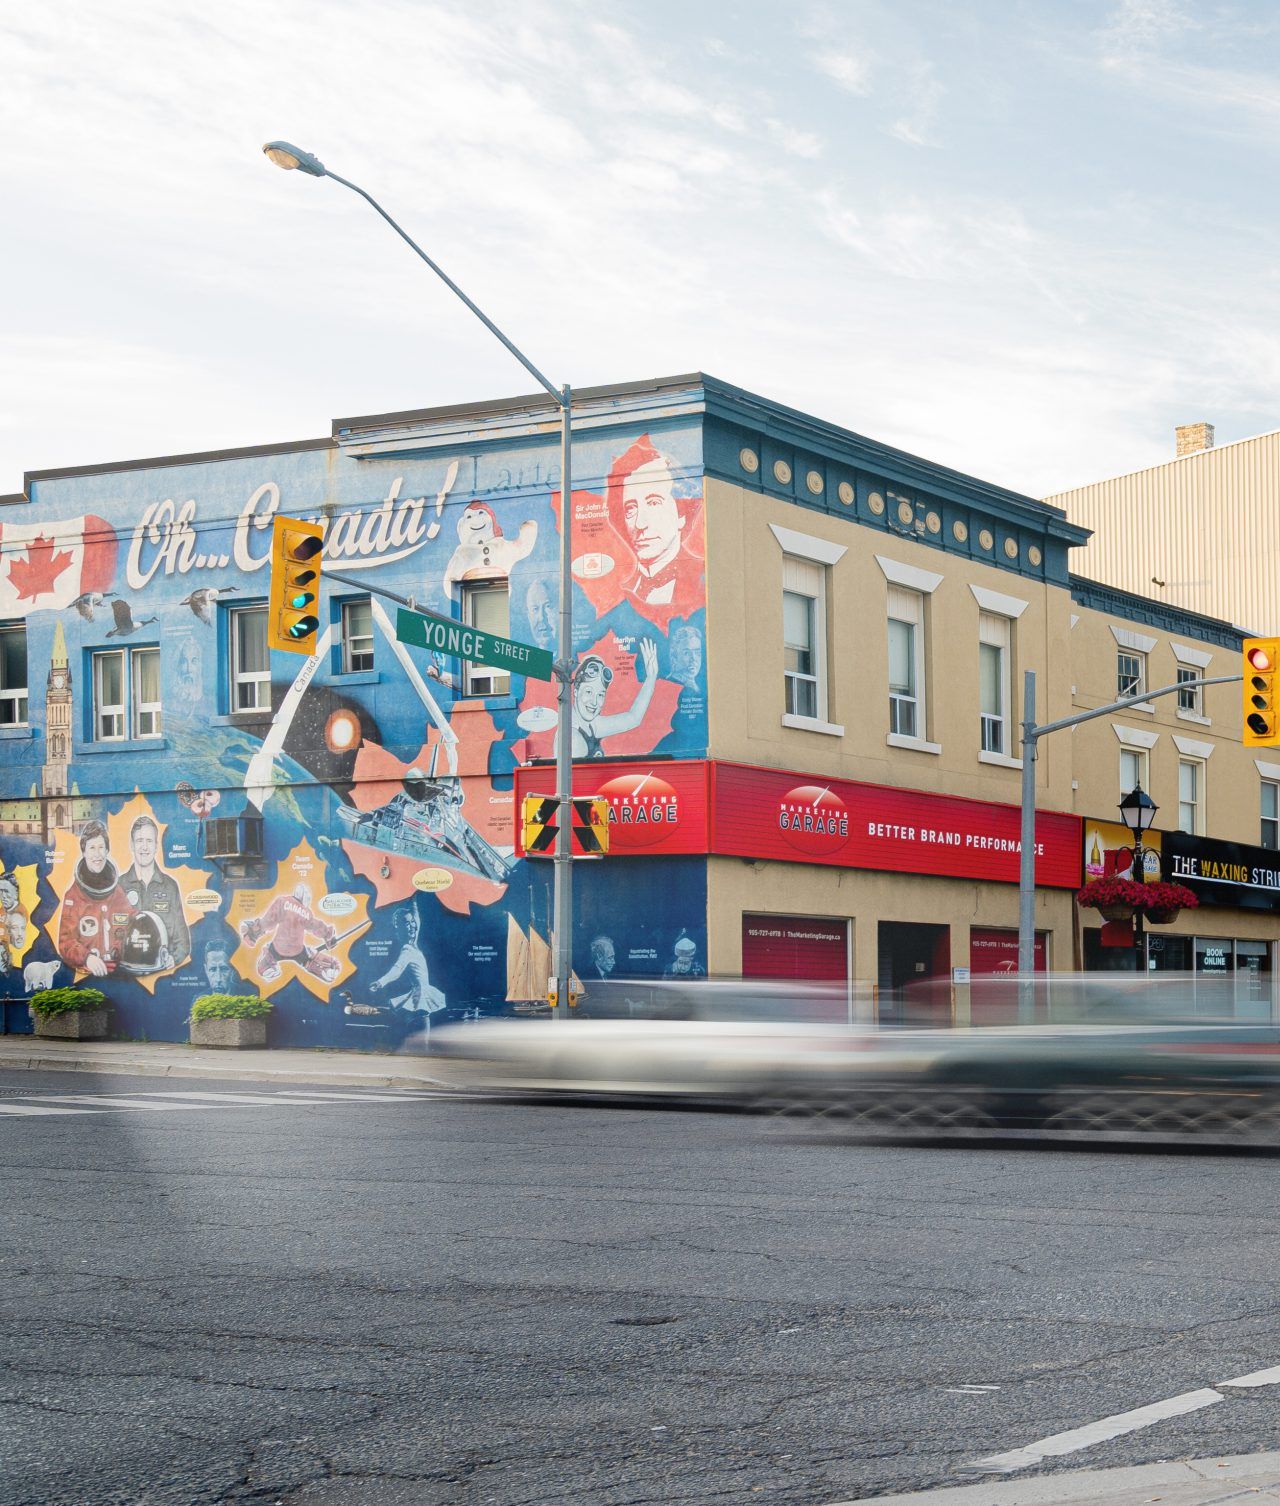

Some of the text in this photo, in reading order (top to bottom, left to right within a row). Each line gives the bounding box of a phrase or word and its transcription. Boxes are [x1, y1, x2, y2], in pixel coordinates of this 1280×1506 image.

[233, 460, 459, 572] Cada!
[423, 620, 531, 662] YONGE STREET
[294, 654, 320, 692] Canada
[603, 796, 677, 805] RKETING
[780, 803, 848, 819] MARKETING
[607, 804, 678, 824] ARAGE
[779, 812, 849, 837] GARAGE
[868, 822, 1044, 856] BETTER BRAND PERFORMAE
[1172, 855, 1197, 875] THE
[1201, 859, 1248, 883] WAXING
[1204, 957, 1226, 966] ONLINE
[1206, 948, 1223, 957] BOOK
